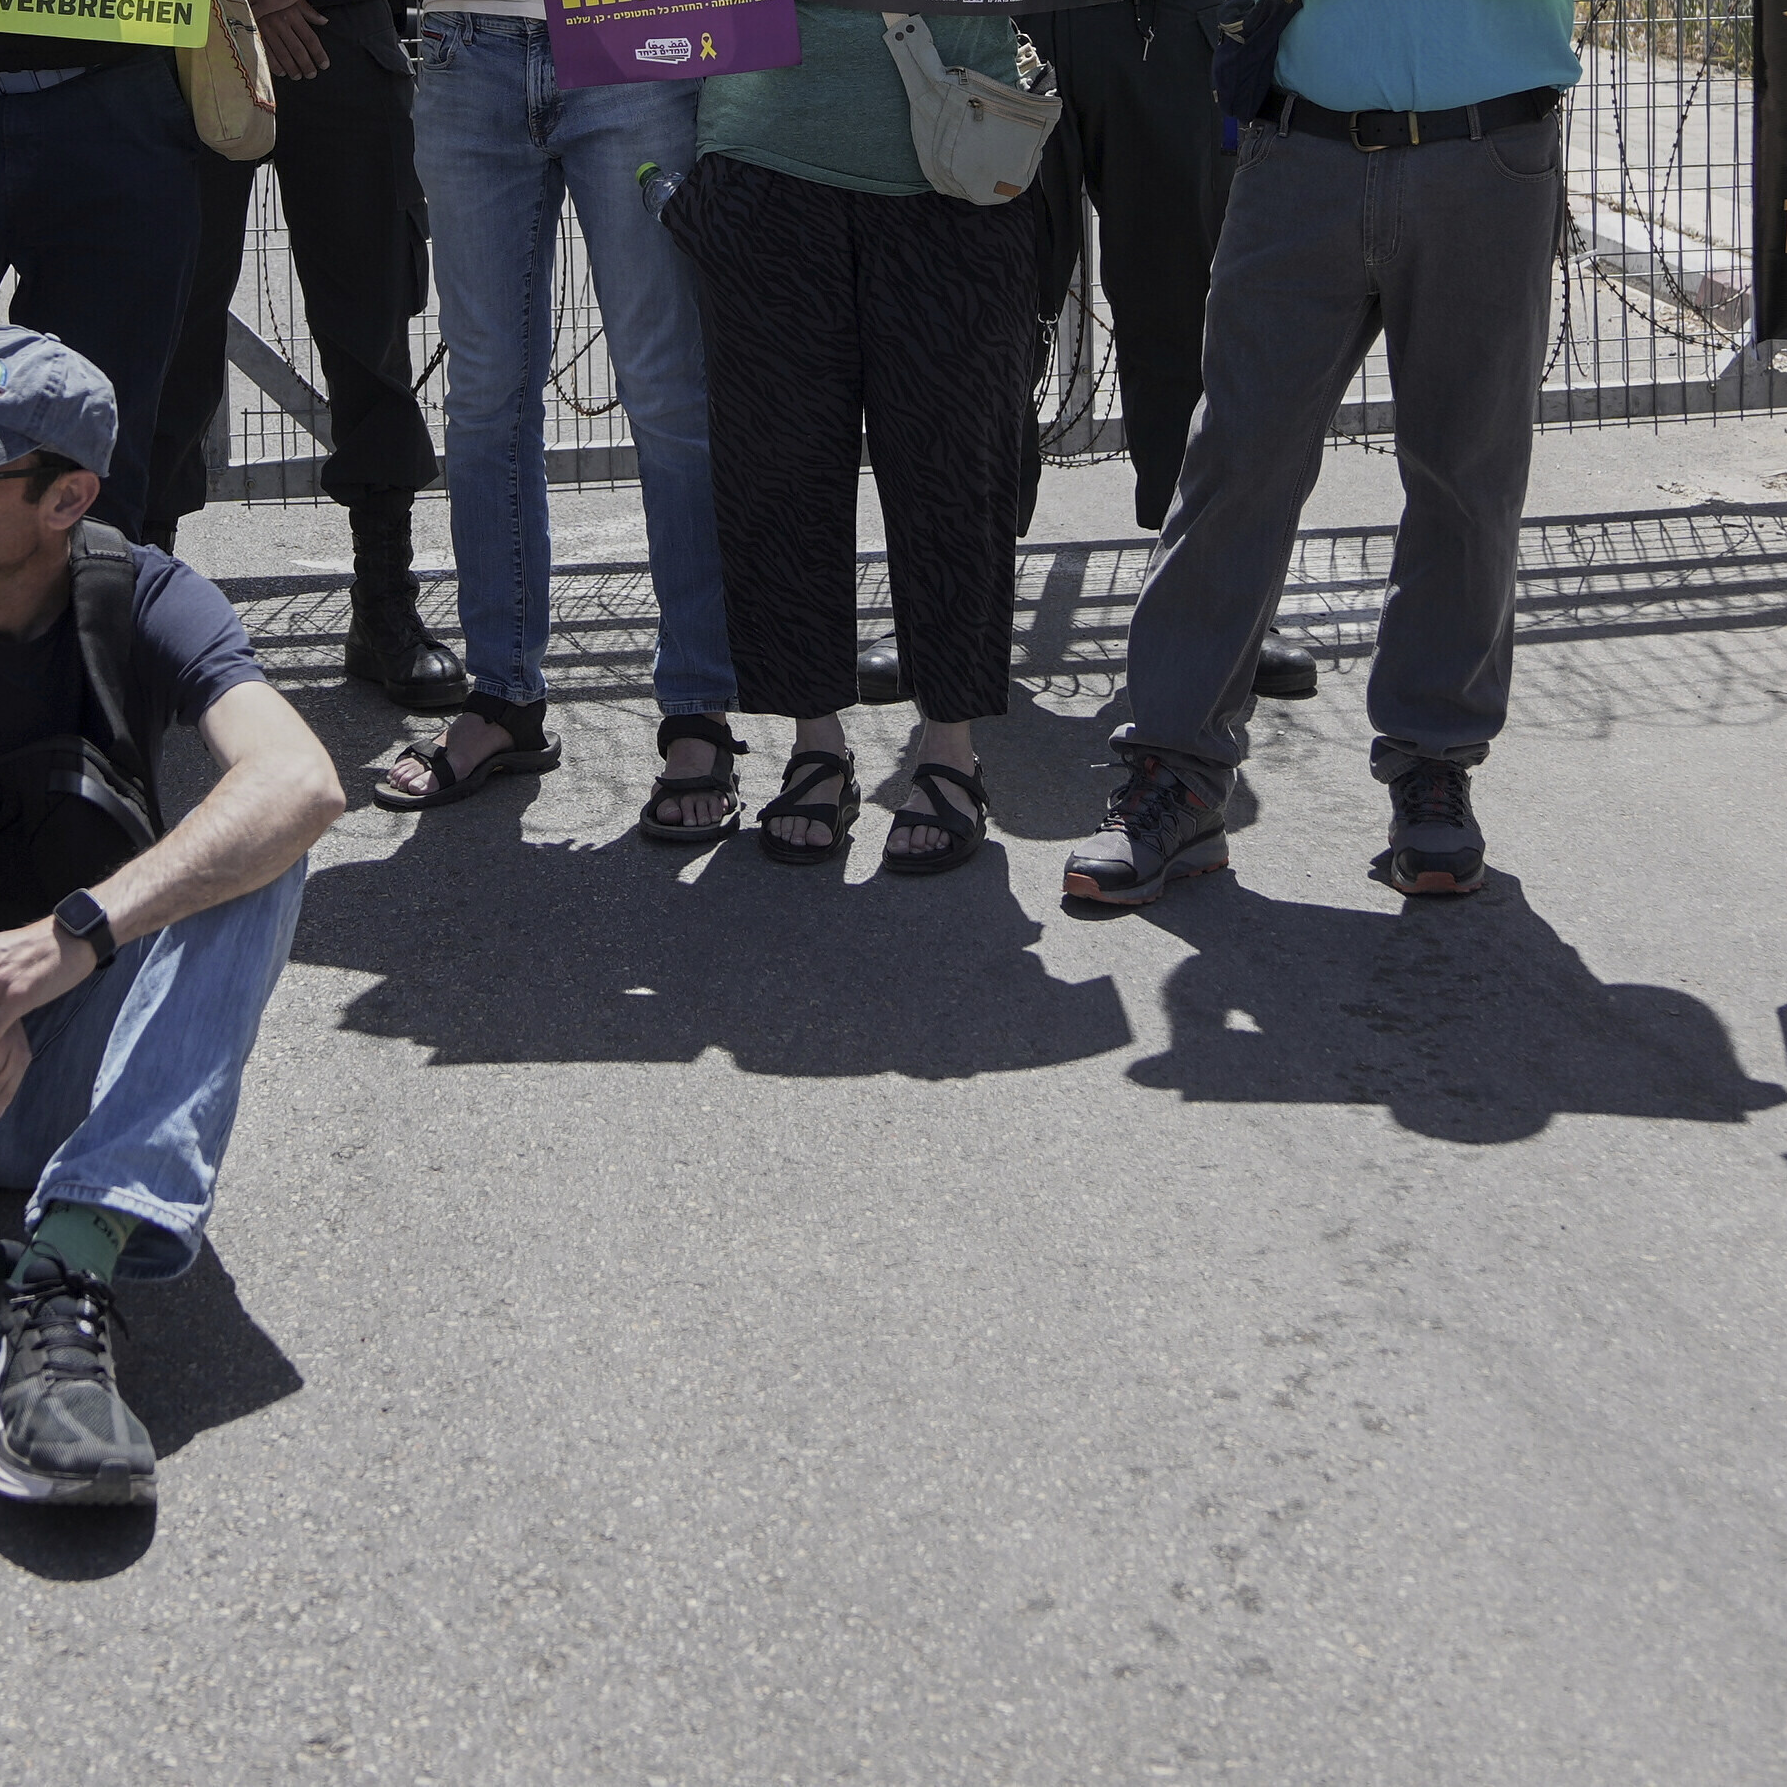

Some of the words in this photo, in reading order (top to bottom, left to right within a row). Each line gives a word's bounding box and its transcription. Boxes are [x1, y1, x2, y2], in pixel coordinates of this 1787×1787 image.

[658, 6, 669, 15] כל
[672, 3, 703, 13] החזרת
[614, 8, 656, 20] החטופים
[566, 17, 591, 26] שלום
[660, 48, 689, 56] עומדים
